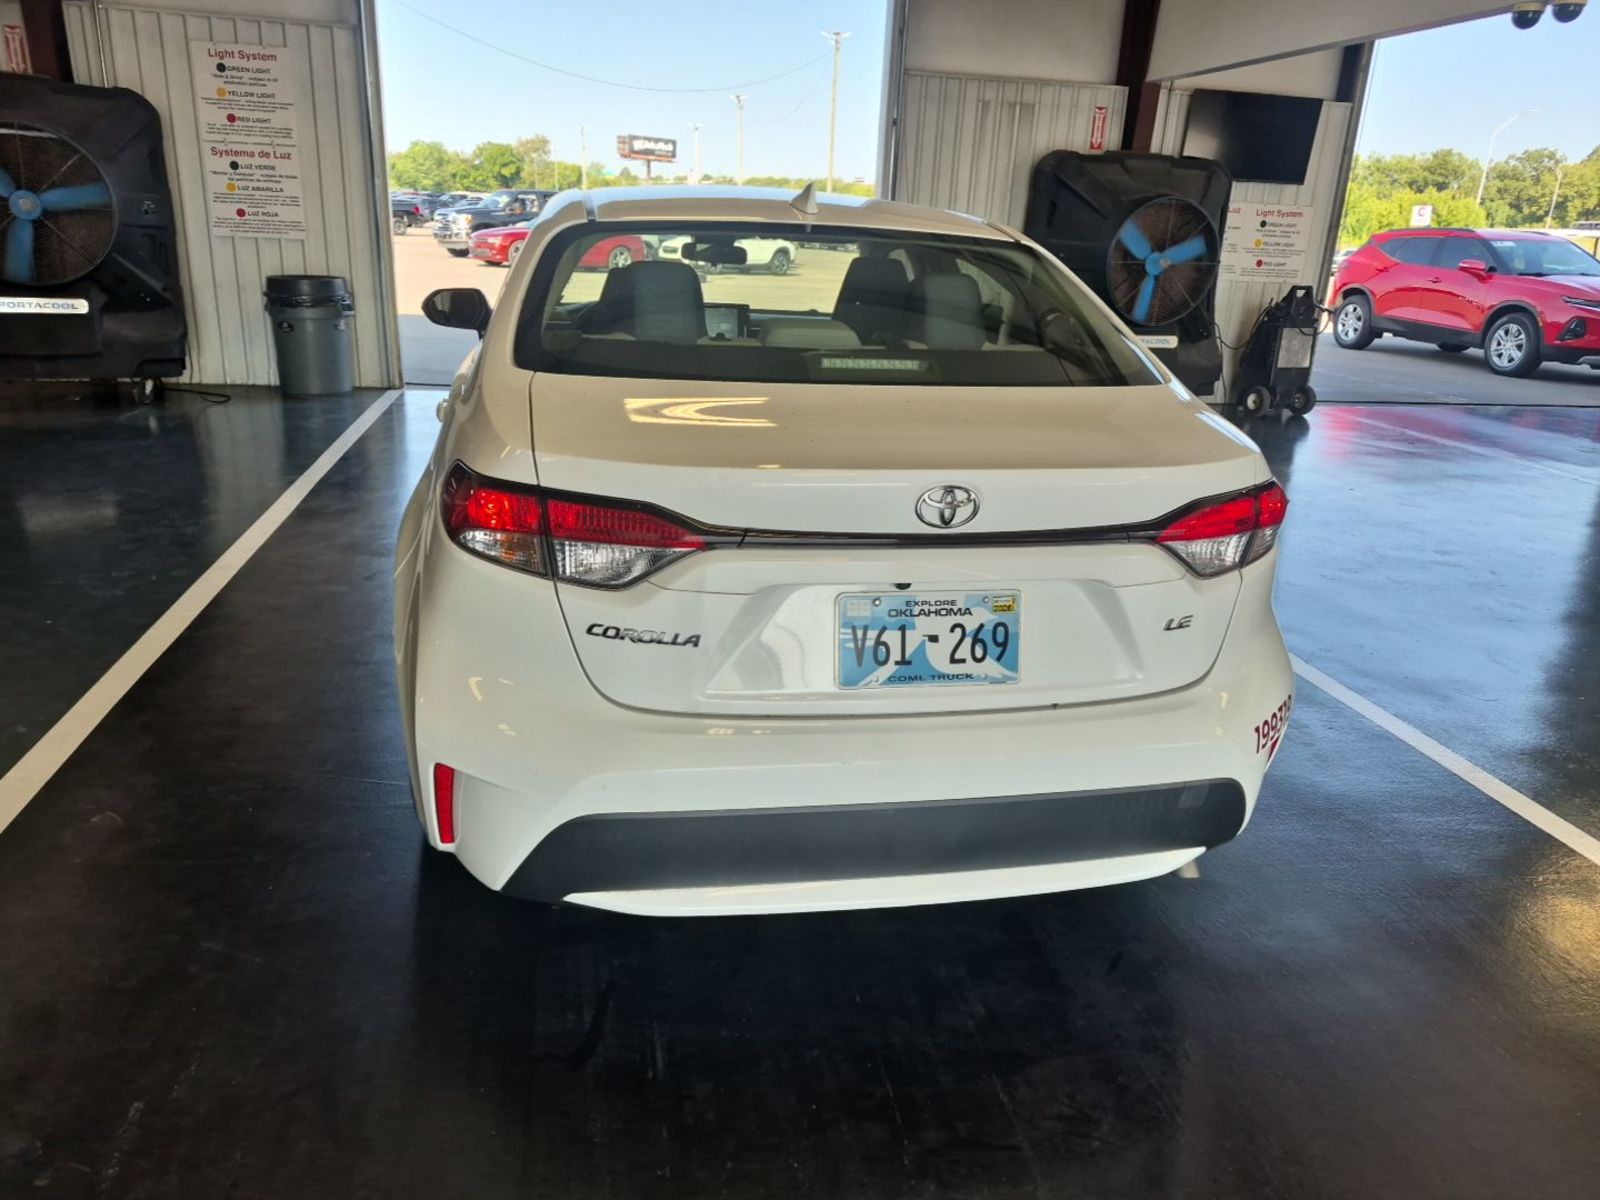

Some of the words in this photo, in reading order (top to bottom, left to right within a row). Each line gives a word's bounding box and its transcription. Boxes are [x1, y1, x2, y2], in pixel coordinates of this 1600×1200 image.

[207, 47, 235, 60] Light
[237, 50, 277, 62] System
[227, 65, 250, 73] GREEN
[227, 90, 255, 98] YELLOW
[237, 116, 251, 124] RED
[210, 146, 255, 158] Systema
[258, 150, 271, 159] de
[273, 150, 292, 160] Luz
[1276, 210, 1303, 219] System
[0, 301, 79, 310] PORTACOOL
[905, 599, 957, 608] EXPLORE
[888, 607, 973, 618] OKLAHOMA
[1163, 614, 1194, 631] LE
[586, 623, 702, 648] COROLLA
[888, 675, 924, 683] COML
[931, 672, 974, 681] TRUCK
